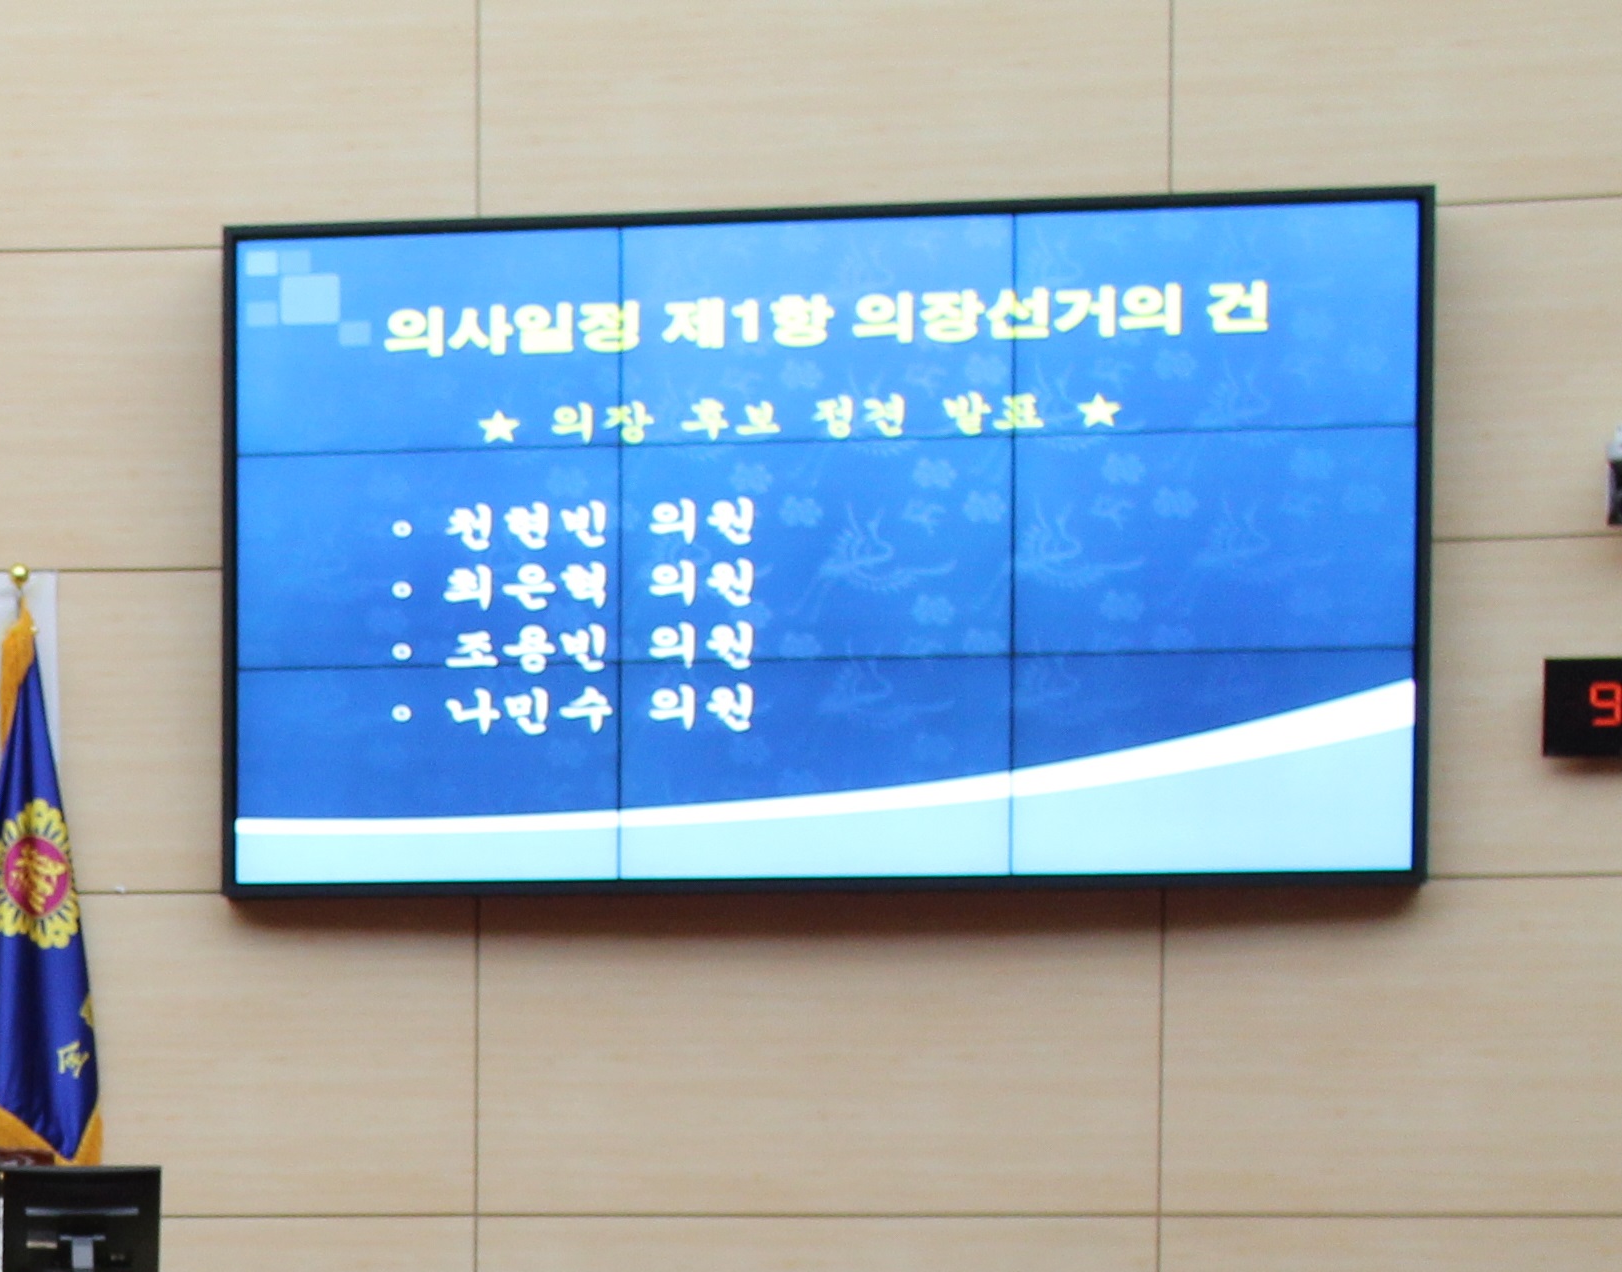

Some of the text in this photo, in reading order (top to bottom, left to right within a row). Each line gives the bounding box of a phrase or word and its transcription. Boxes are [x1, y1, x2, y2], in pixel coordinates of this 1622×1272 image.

[384, 279, 1269, 357] 의사일정 제1항 의장선거의 건
[552, 391, 1045, 444] 의장 후보 정견 발표
[649, 496, 755, 546] 의원
[649, 557, 755, 607] 의원
[445, 619, 755, 674] 조용빈 의원
[445, 682, 755, 736] 나민수 의원
